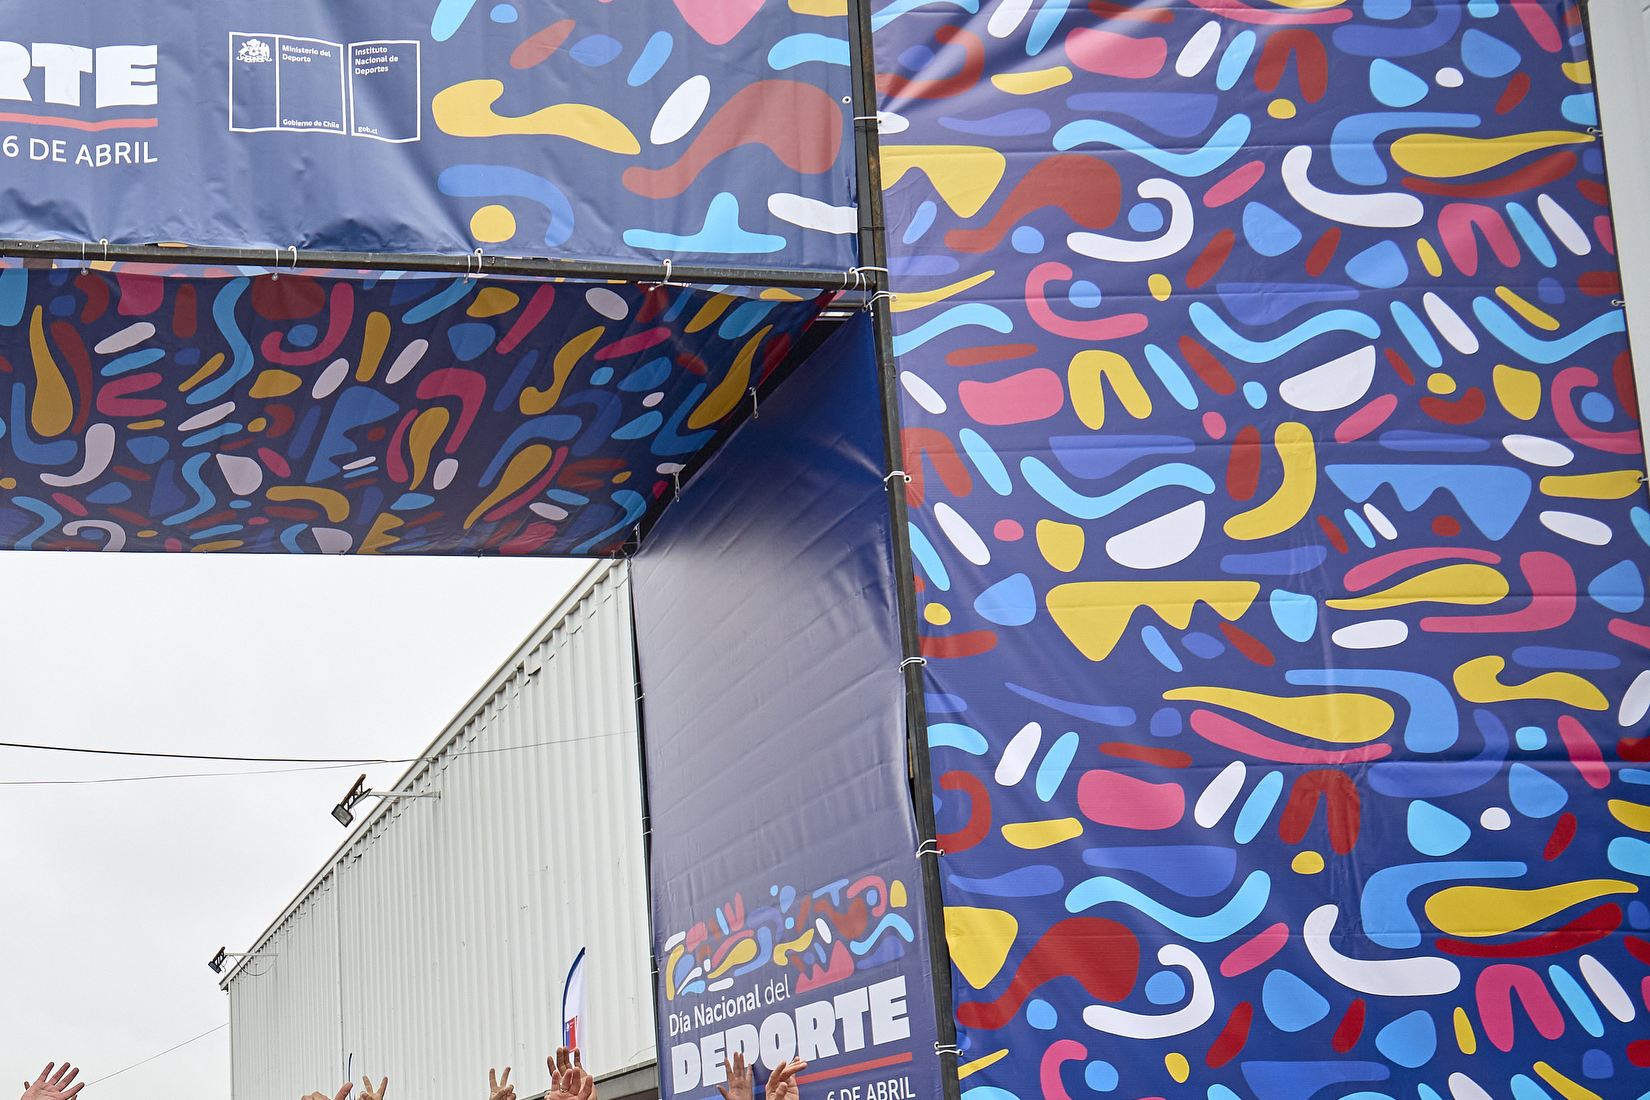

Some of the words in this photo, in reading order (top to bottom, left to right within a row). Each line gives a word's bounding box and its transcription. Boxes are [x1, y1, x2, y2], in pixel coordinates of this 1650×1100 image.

[282, 45, 318, 55] Ministerio
[320, 49, 331, 57] del
[355, 47, 387, 56] Instituto
[283, 54, 311, 63] Deporte
[355, 55, 388, 65] Nacional
[355, 65, 389, 75] Deportes
[283, 119, 312, 127] Gobierno
[323, 120, 339, 128] Chile
[358, 126, 378, 135] gob.cl
[2, 135, 19, 158] 6
[30, 138, 67, 163] DE
[75, 142, 157, 167] ABRIL
[669, 1011, 691, 1037] Día
[694, 984, 761, 1028] Nacional
[765, 974, 790, 1005] del
[671, 975, 911, 1095] DEPORTE
